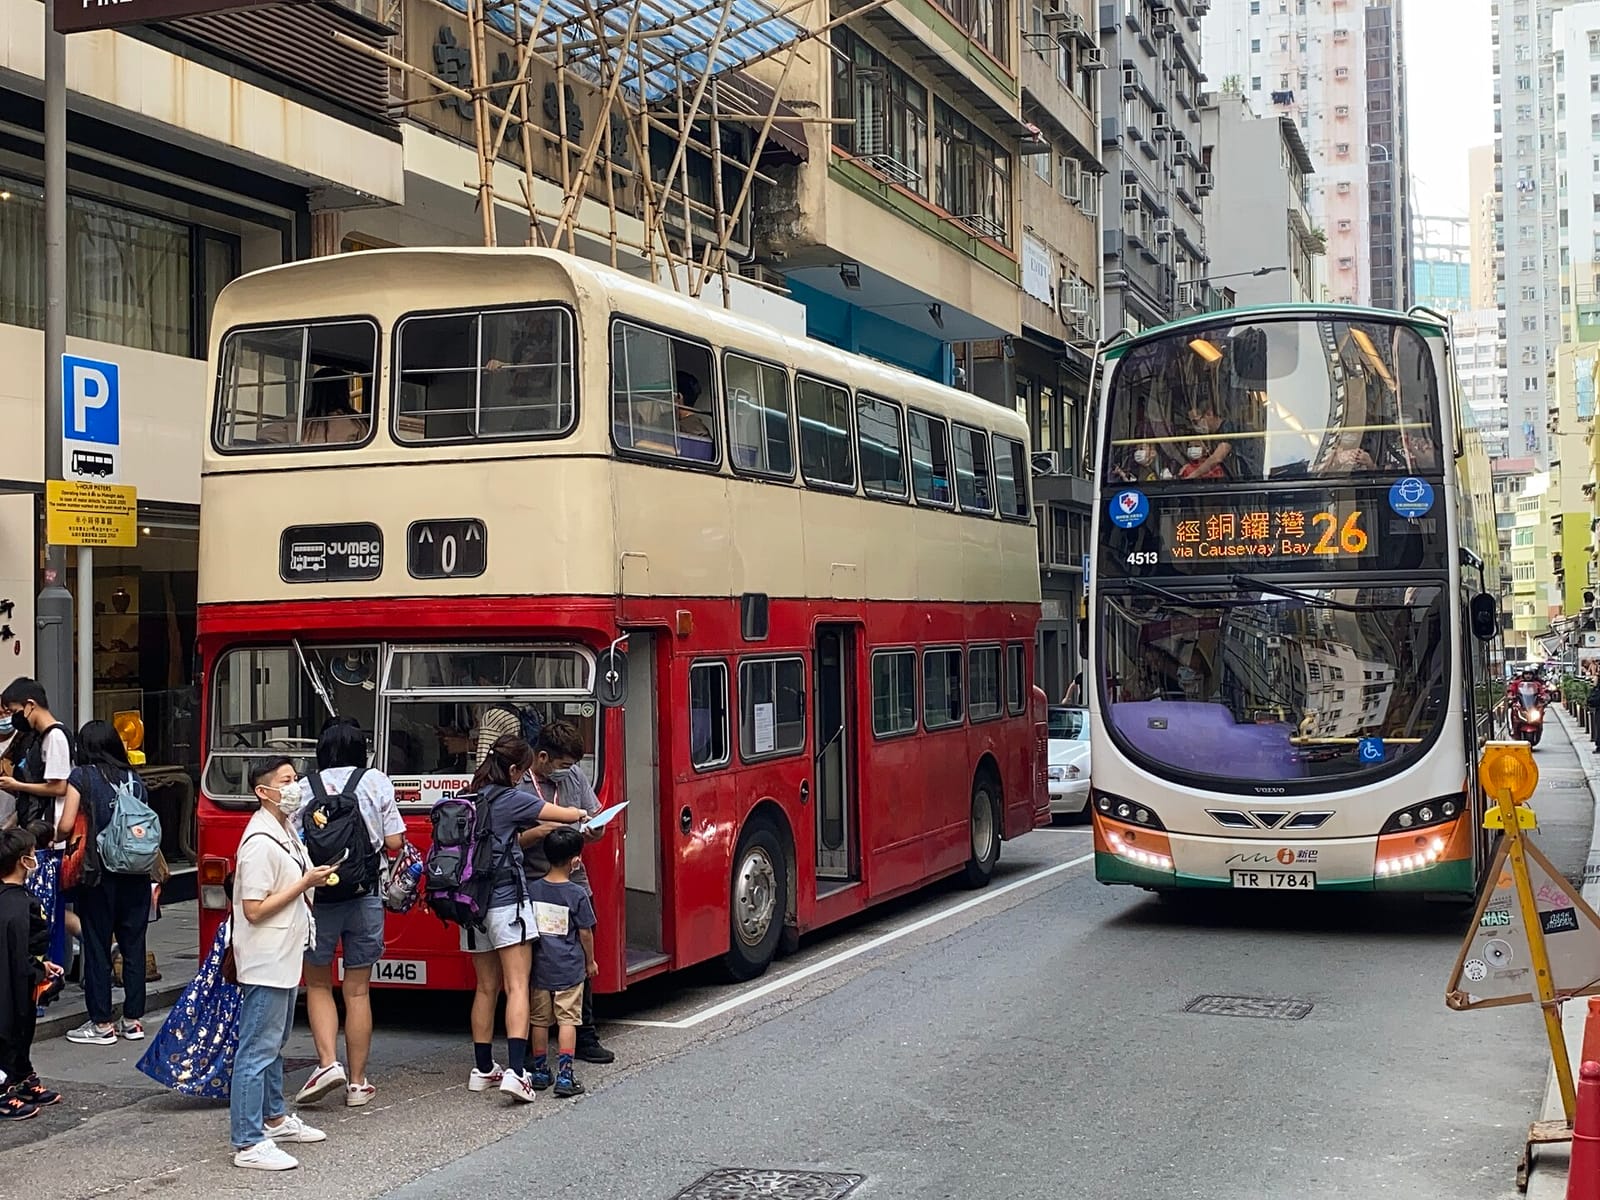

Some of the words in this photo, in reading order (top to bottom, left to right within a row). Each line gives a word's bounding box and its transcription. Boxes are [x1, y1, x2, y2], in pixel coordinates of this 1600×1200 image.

[73, 365, 110, 433] P
[1176, 511, 1305, 542] 經銅鑼灣
[1312, 511, 1368, 555] 26
[327, 541, 380, 555] JUMBO
[1172, 544, 1193, 558] via
[1198, 542, 1276, 557] Causeway
[1281, 540, 1311, 556] Bay
[349, 555, 380, 568] BUS
[1126, 552, 1158, 565] 4513
[423, 779, 470, 790] JUMBO
[1297, 849, 1319, 859] 新巴
[1238, 873, 1260, 887] TR
[1269, 874, 1310, 888] 1784
[376, 963, 417, 980] 1446
